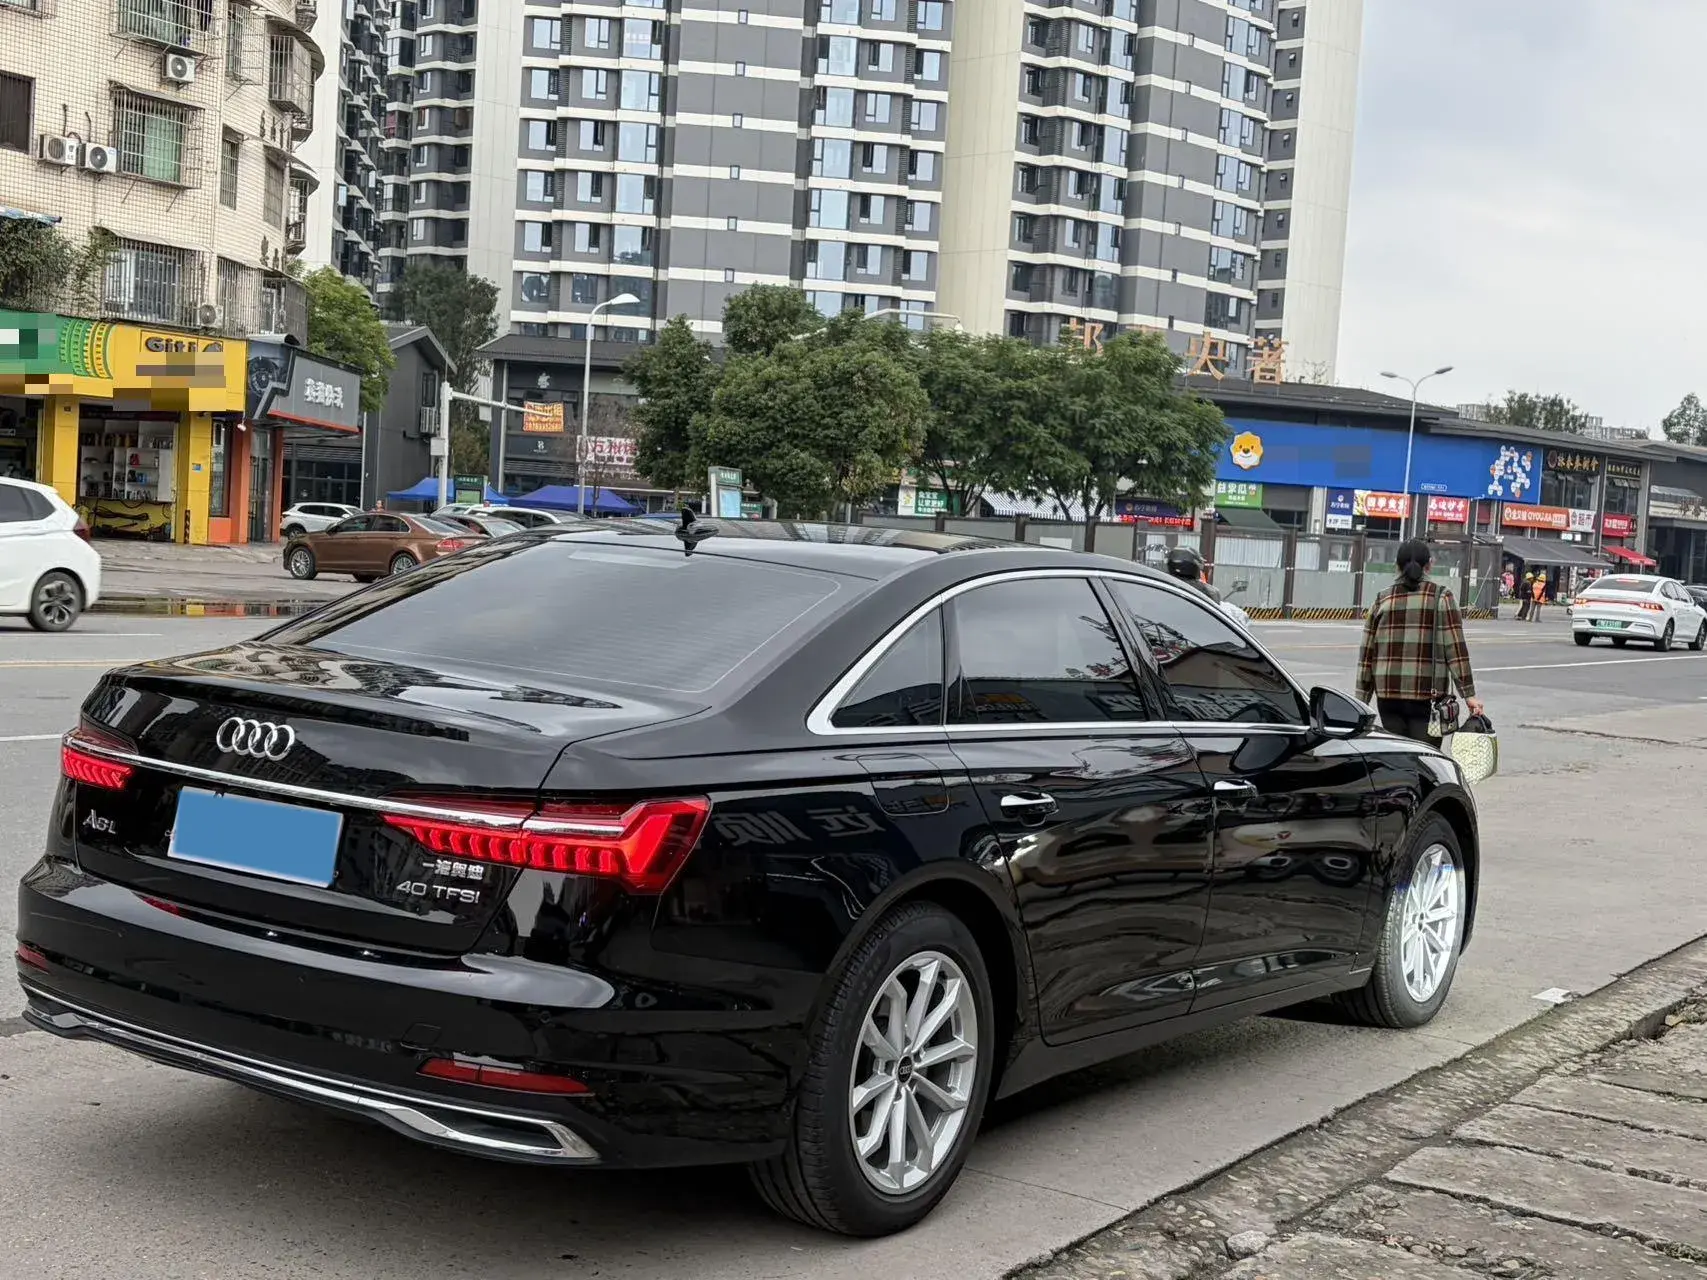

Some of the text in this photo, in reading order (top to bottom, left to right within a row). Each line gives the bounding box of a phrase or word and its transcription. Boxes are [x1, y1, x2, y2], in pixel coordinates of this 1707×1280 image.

[82, 808, 117, 835] A6L
[396, 880, 480, 904] 40 TFSI
